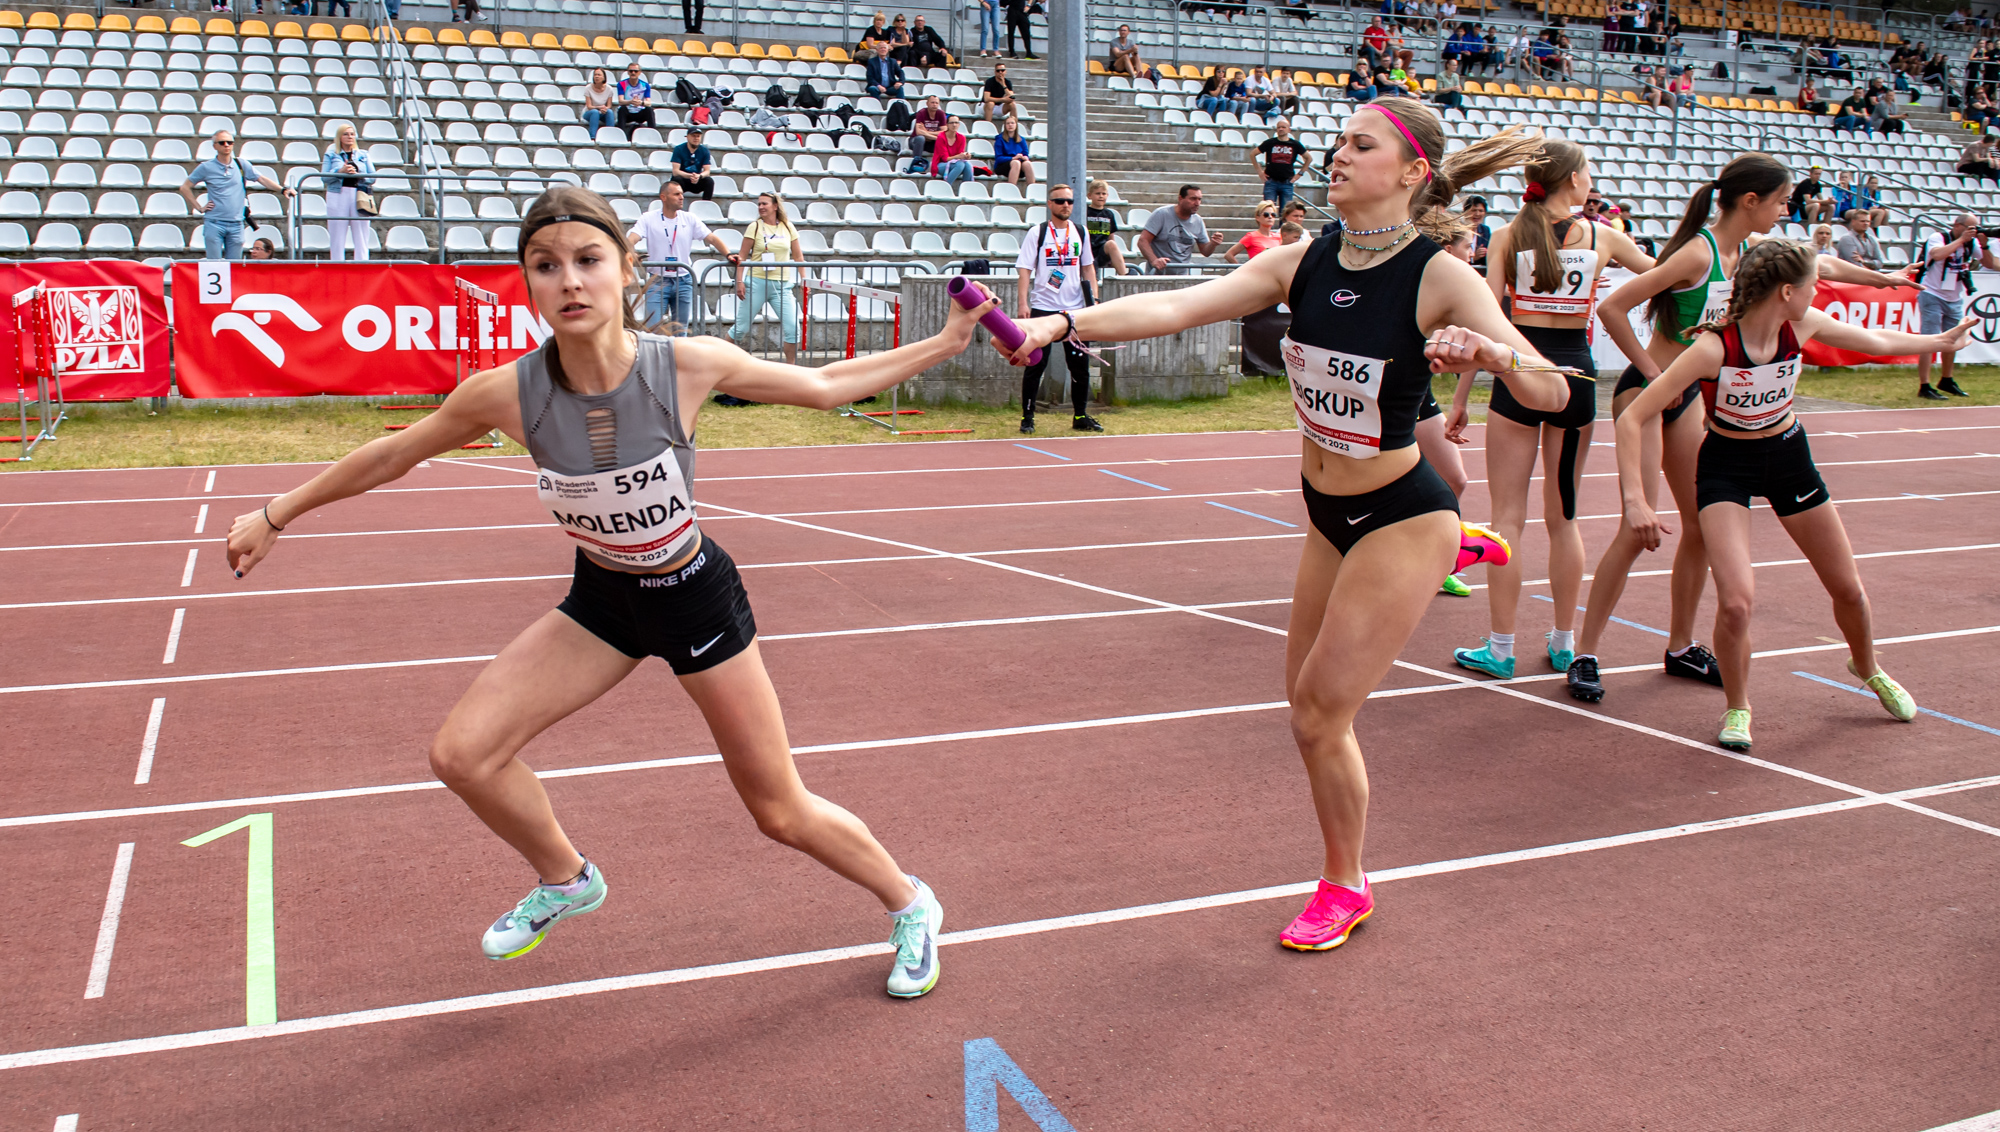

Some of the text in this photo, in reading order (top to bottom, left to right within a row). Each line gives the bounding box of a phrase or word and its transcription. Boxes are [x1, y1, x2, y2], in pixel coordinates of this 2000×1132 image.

[206, 272, 223, 295] 3
[341, 303, 555, 352] ORLEN
[1823, 300, 1921, 334] ORLEN
[56, 344, 139, 371] PZLA
[1326, 356, 1370, 384] 586
[1776, 363, 1795, 379] 51
[1328, 439, 1350, 452] 2023
[554, 479, 596, 488] Akademia
[556, 486, 599, 494] Pomorska
[614, 461, 668, 495] 594
[552, 494, 687, 534] MOLENDA
[640, 548, 668, 562] 2023
[640, 551, 706, 588] NIKE PRO
